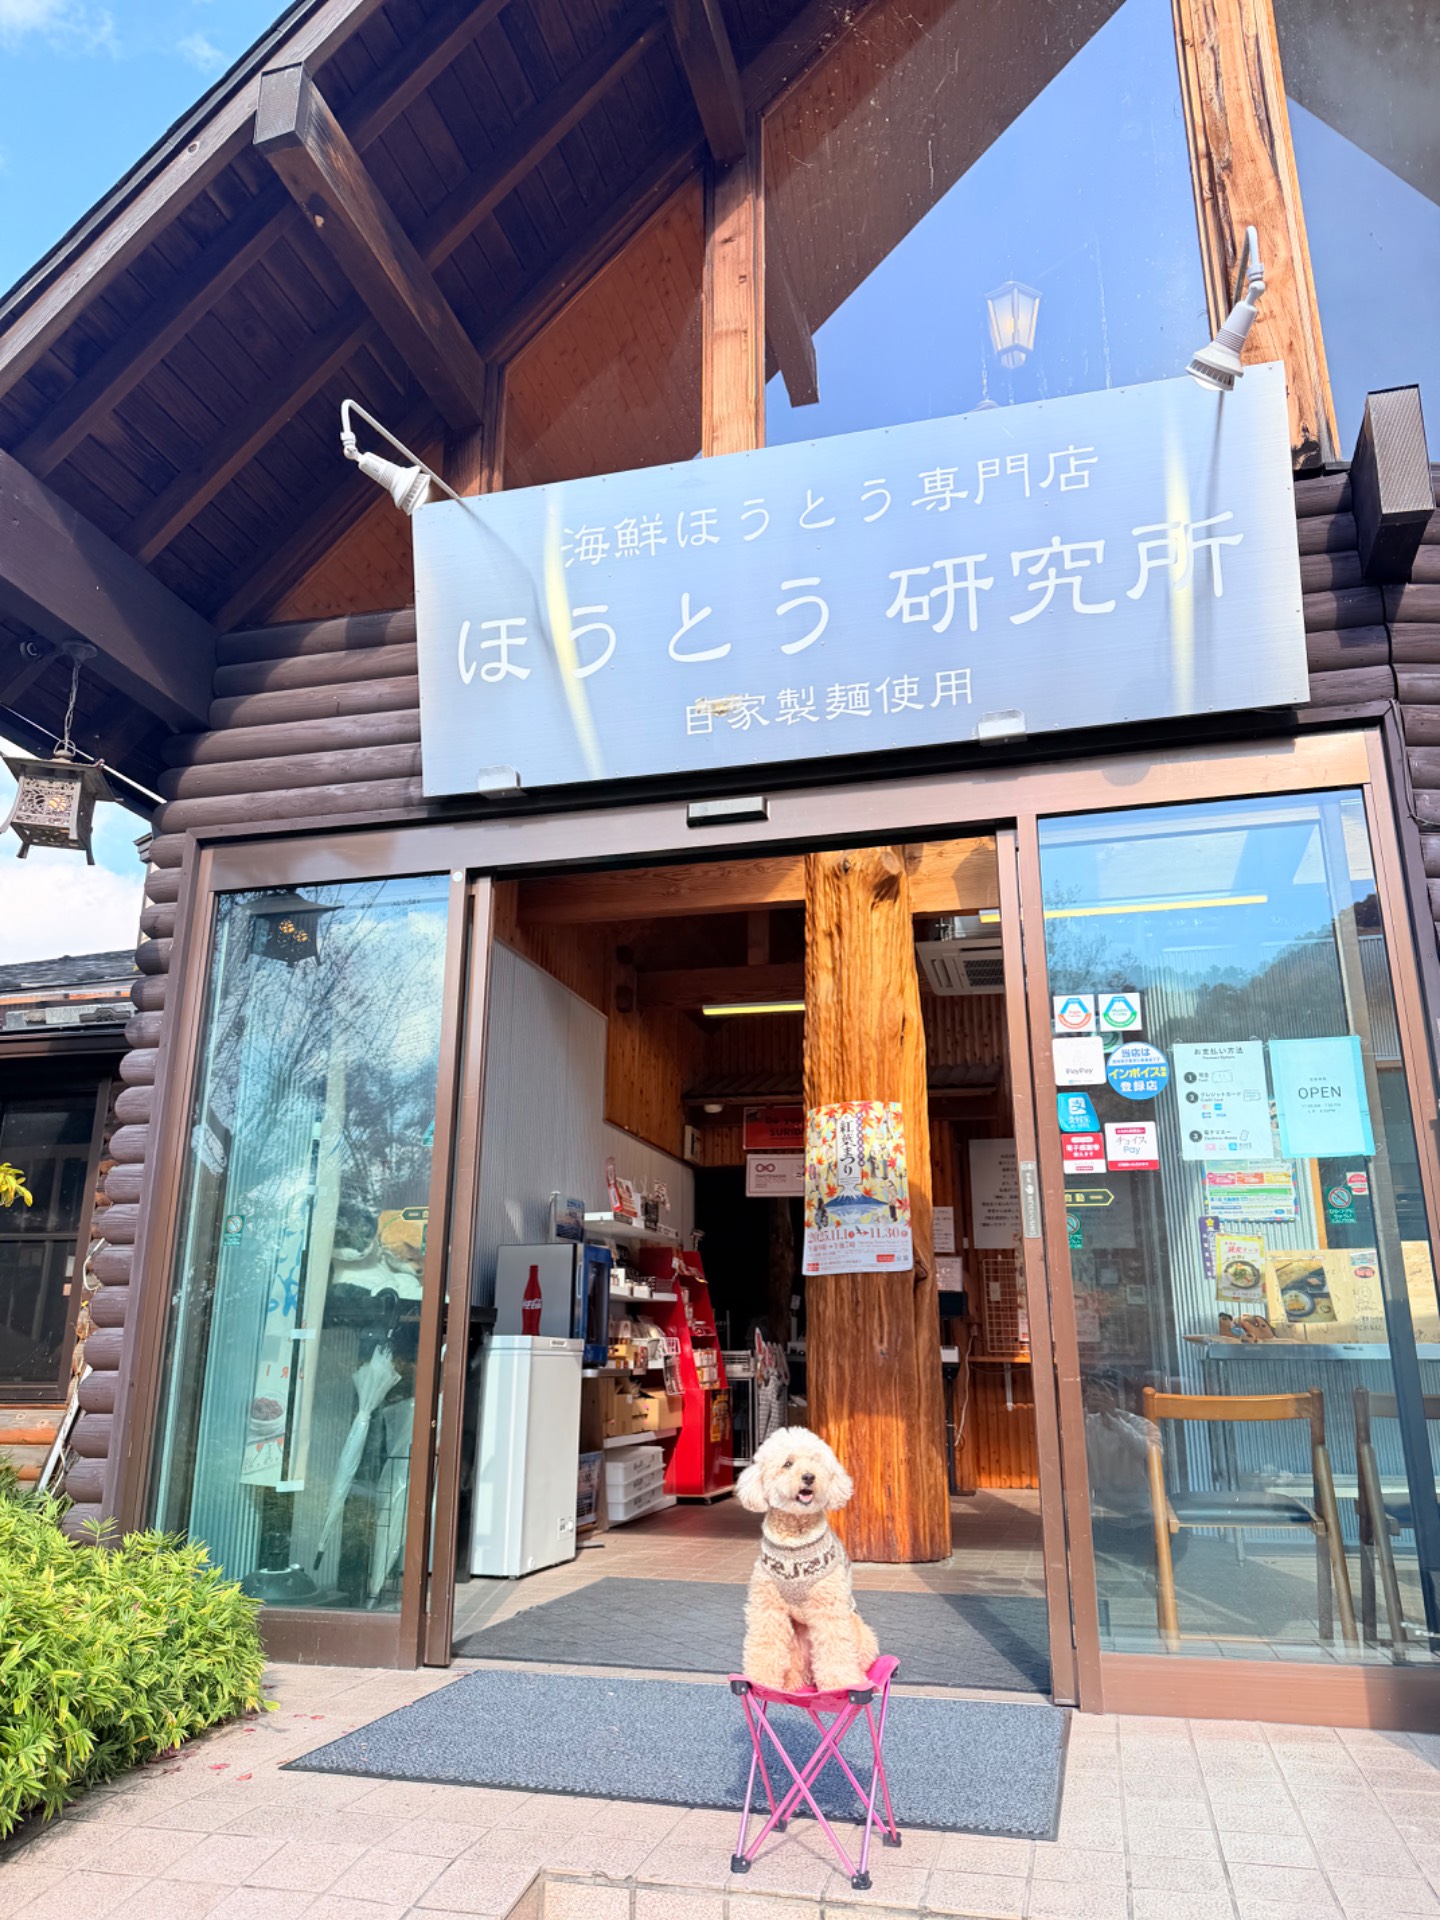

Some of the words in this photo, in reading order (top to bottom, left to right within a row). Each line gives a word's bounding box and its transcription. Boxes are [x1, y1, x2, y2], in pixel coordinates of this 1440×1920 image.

[559, 444, 1100, 569] 海鮮ほうとう専門店
[457, 510, 1245, 685] ほうとう研究所
[685, 667, 974, 736] 自家製麺使用
[1298, 1085, 1342, 1100] OPEN
[840, 1120, 857, 1177] 紅葉まつり
[1123, 1145, 1141, 1155] Pay
